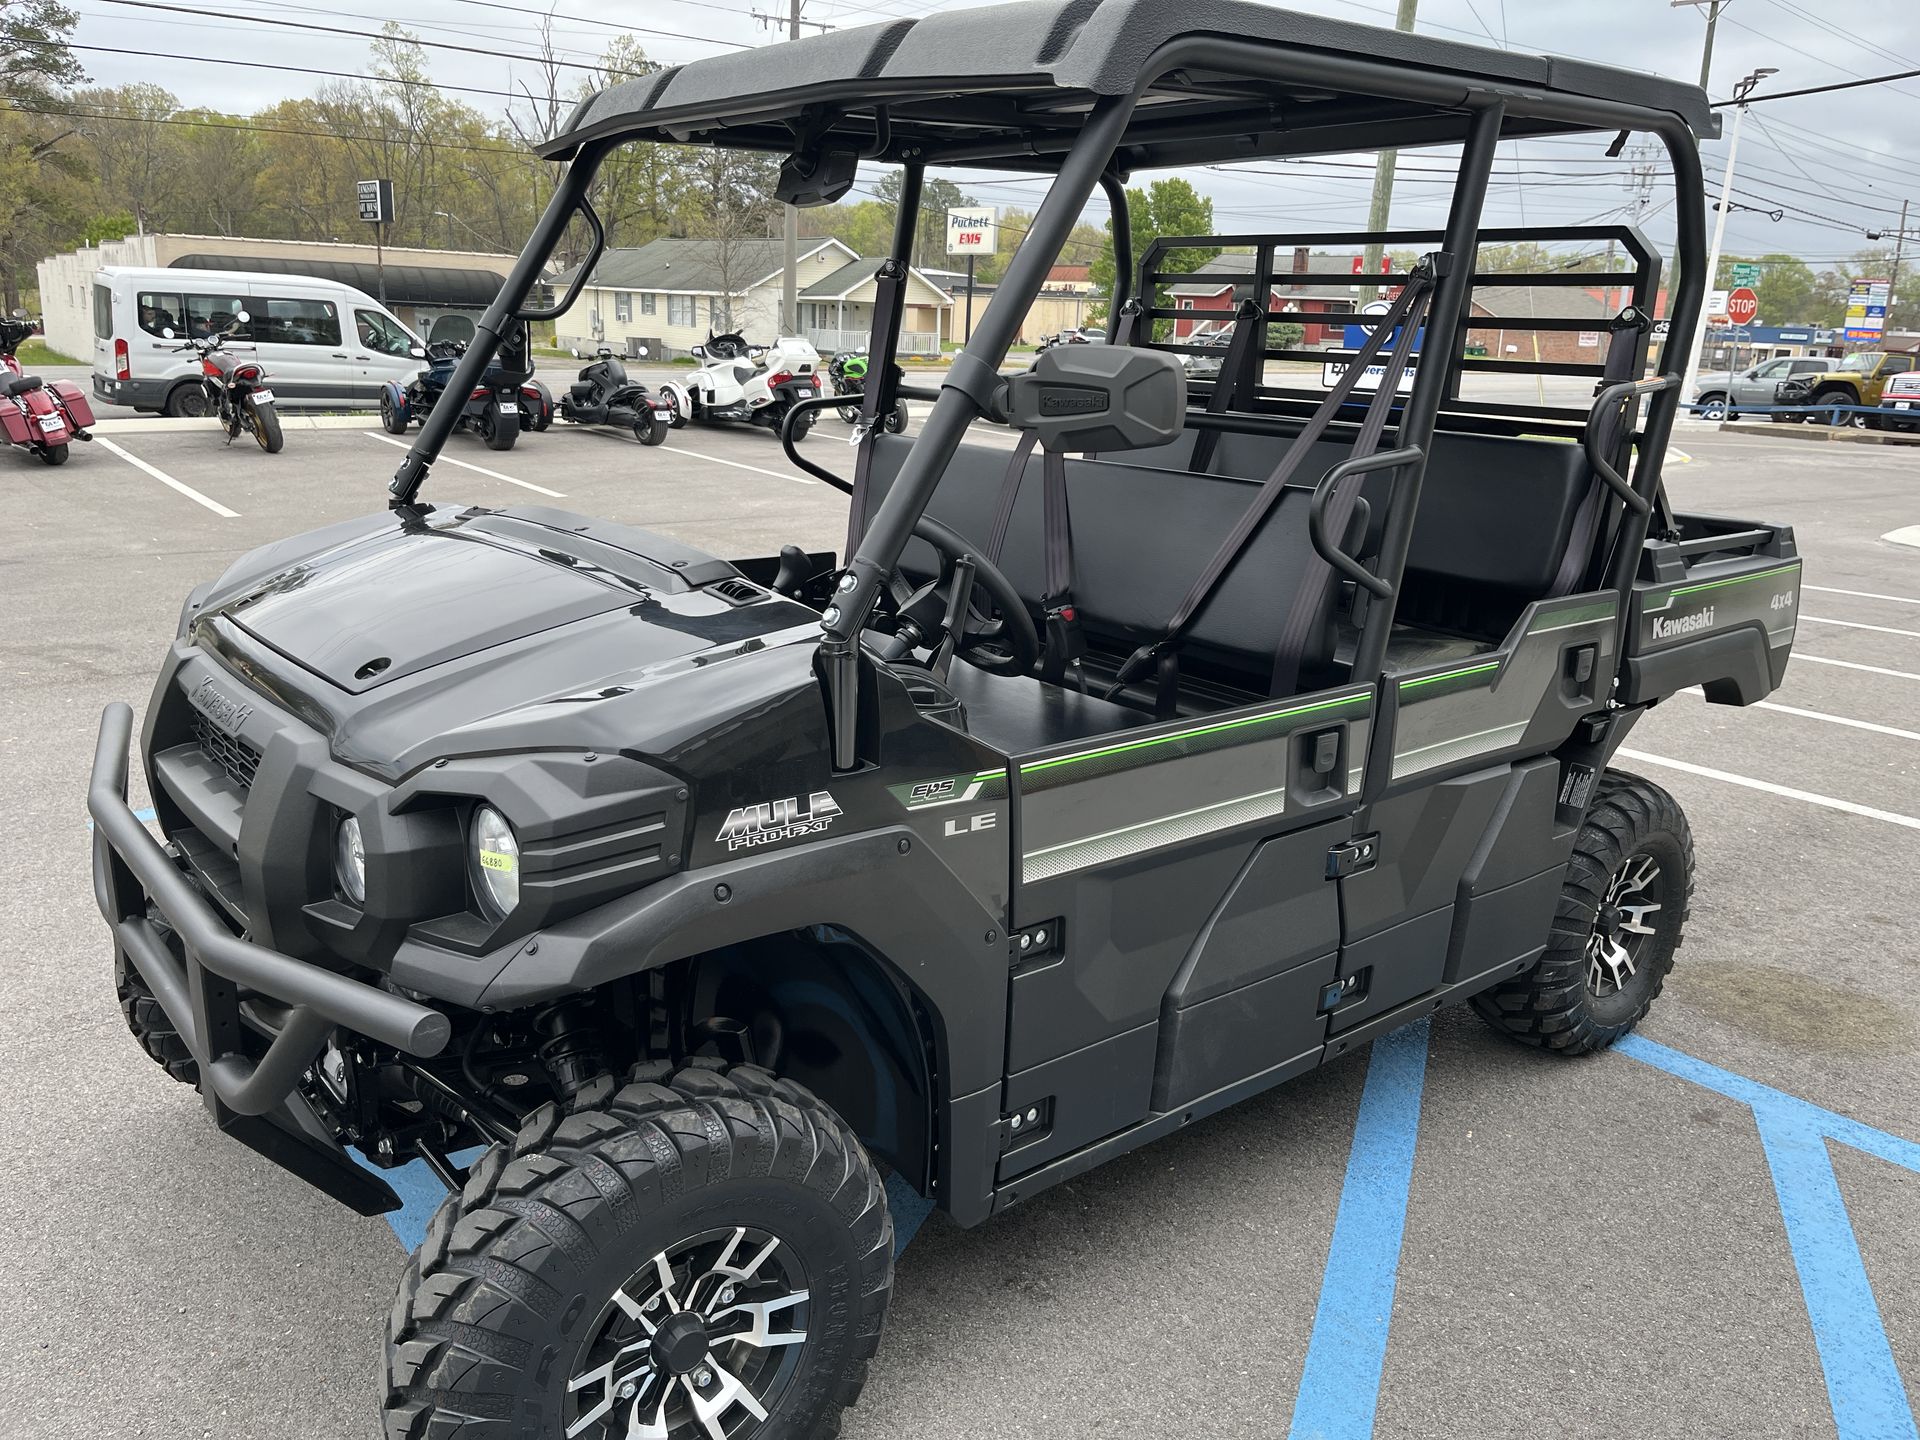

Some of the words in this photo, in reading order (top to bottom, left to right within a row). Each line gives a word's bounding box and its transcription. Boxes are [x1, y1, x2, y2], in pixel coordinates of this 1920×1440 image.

[951, 216, 989, 228] Puckett
[959, 233, 982, 245] EMS
[1729, 298, 1756, 314] STOP
[1043, 392, 1105, 410] Kawasaki
[1770, 590, 1793, 611] 4x4
[1652, 606, 1715, 640] Kawasaki
[192, 674, 254, 734] Kawasaki
[715, 790, 844, 842] MULE
[944, 812, 996, 837] LE
[728, 817, 833, 852] PRO-FXT
